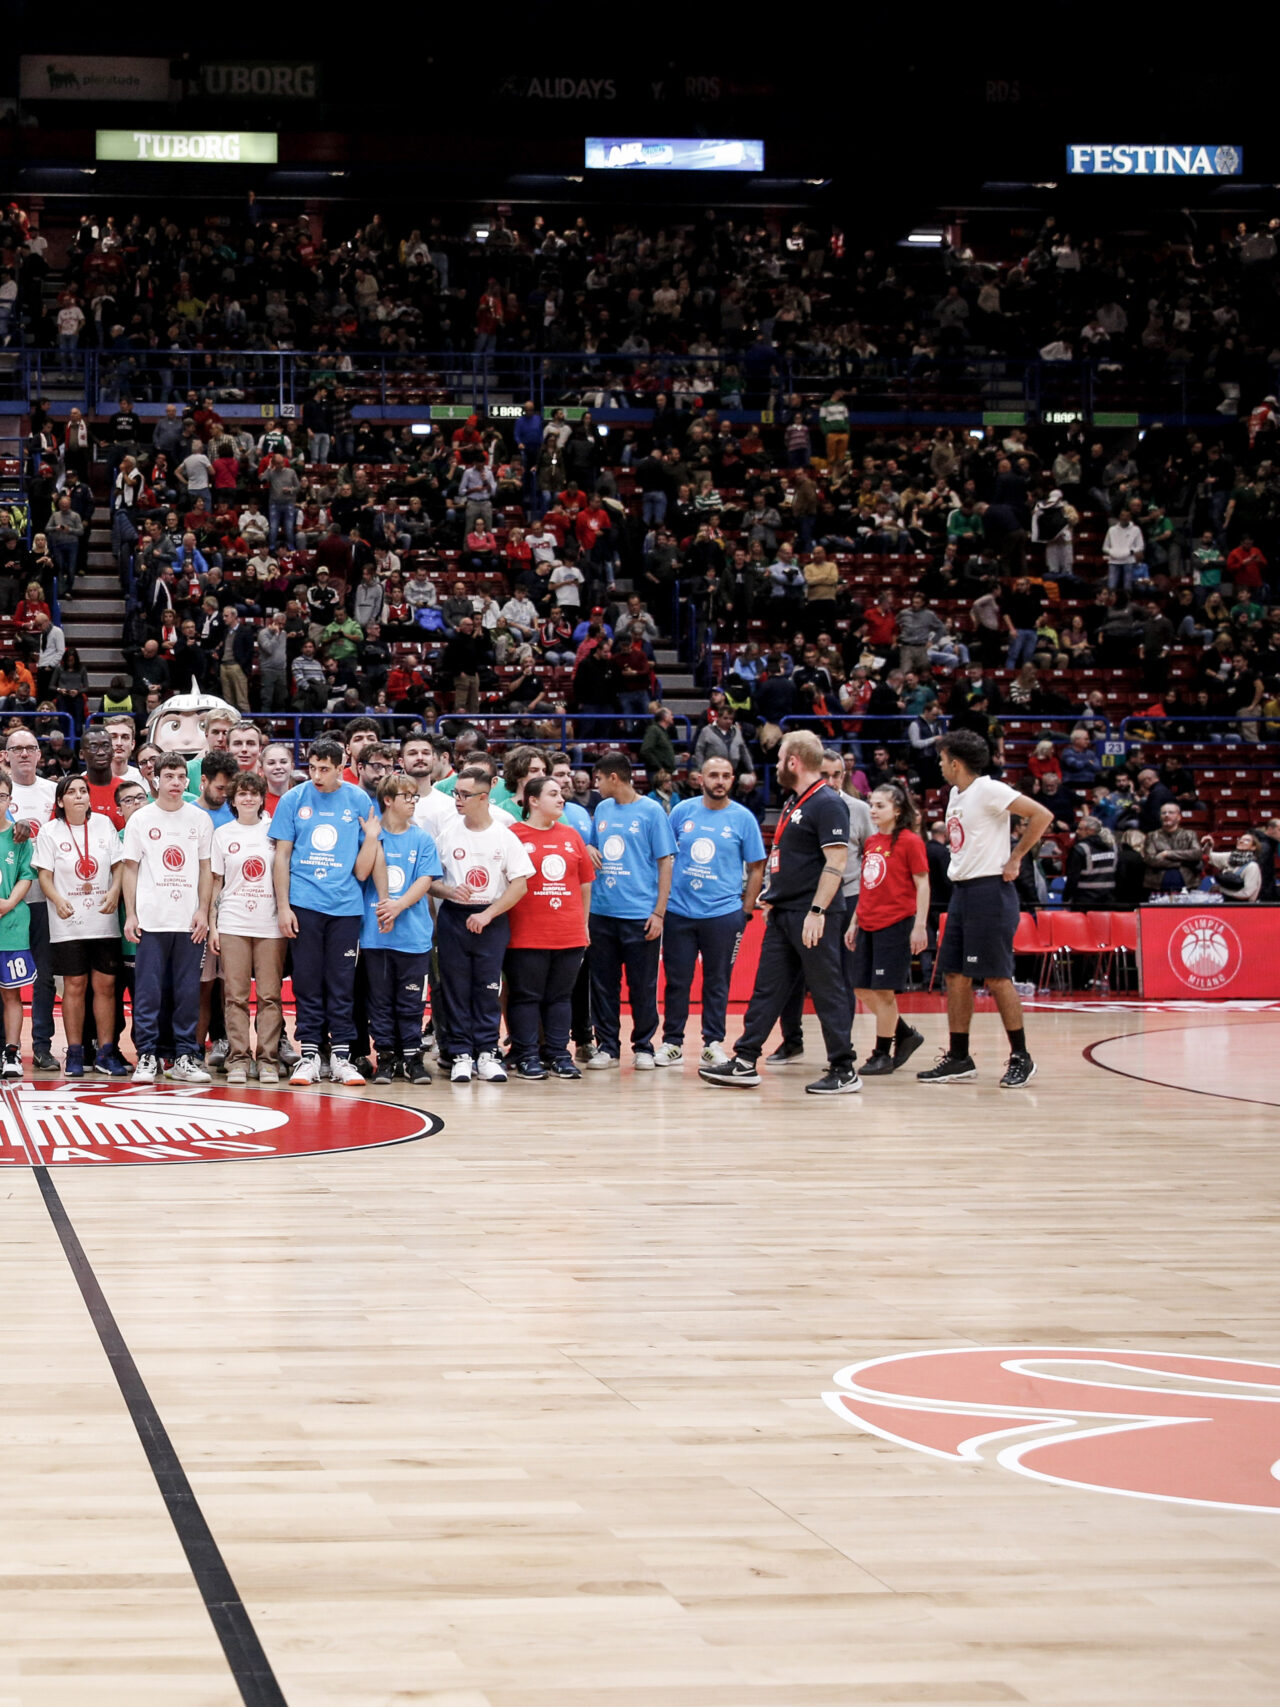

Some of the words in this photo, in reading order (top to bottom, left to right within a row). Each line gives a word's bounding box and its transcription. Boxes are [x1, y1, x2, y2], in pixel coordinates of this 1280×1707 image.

[82, 77, 140, 87] plenitude
[526, 79, 617, 100] ALIDAYS
[133, 133, 241, 161] TUBORG
[1070, 145, 1215, 174] FESTINA
[282, 406, 294, 414] 22
[500, 406, 523, 416] BAR
[1107, 743, 1124, 754] 23
[300, 859, 330, 867] BASKETBALL
[1181, 917, 1226, 935] OLIMPIA
[6, 956, 28, 980] 18
[1187, 973, 1226, 988] MILANO
